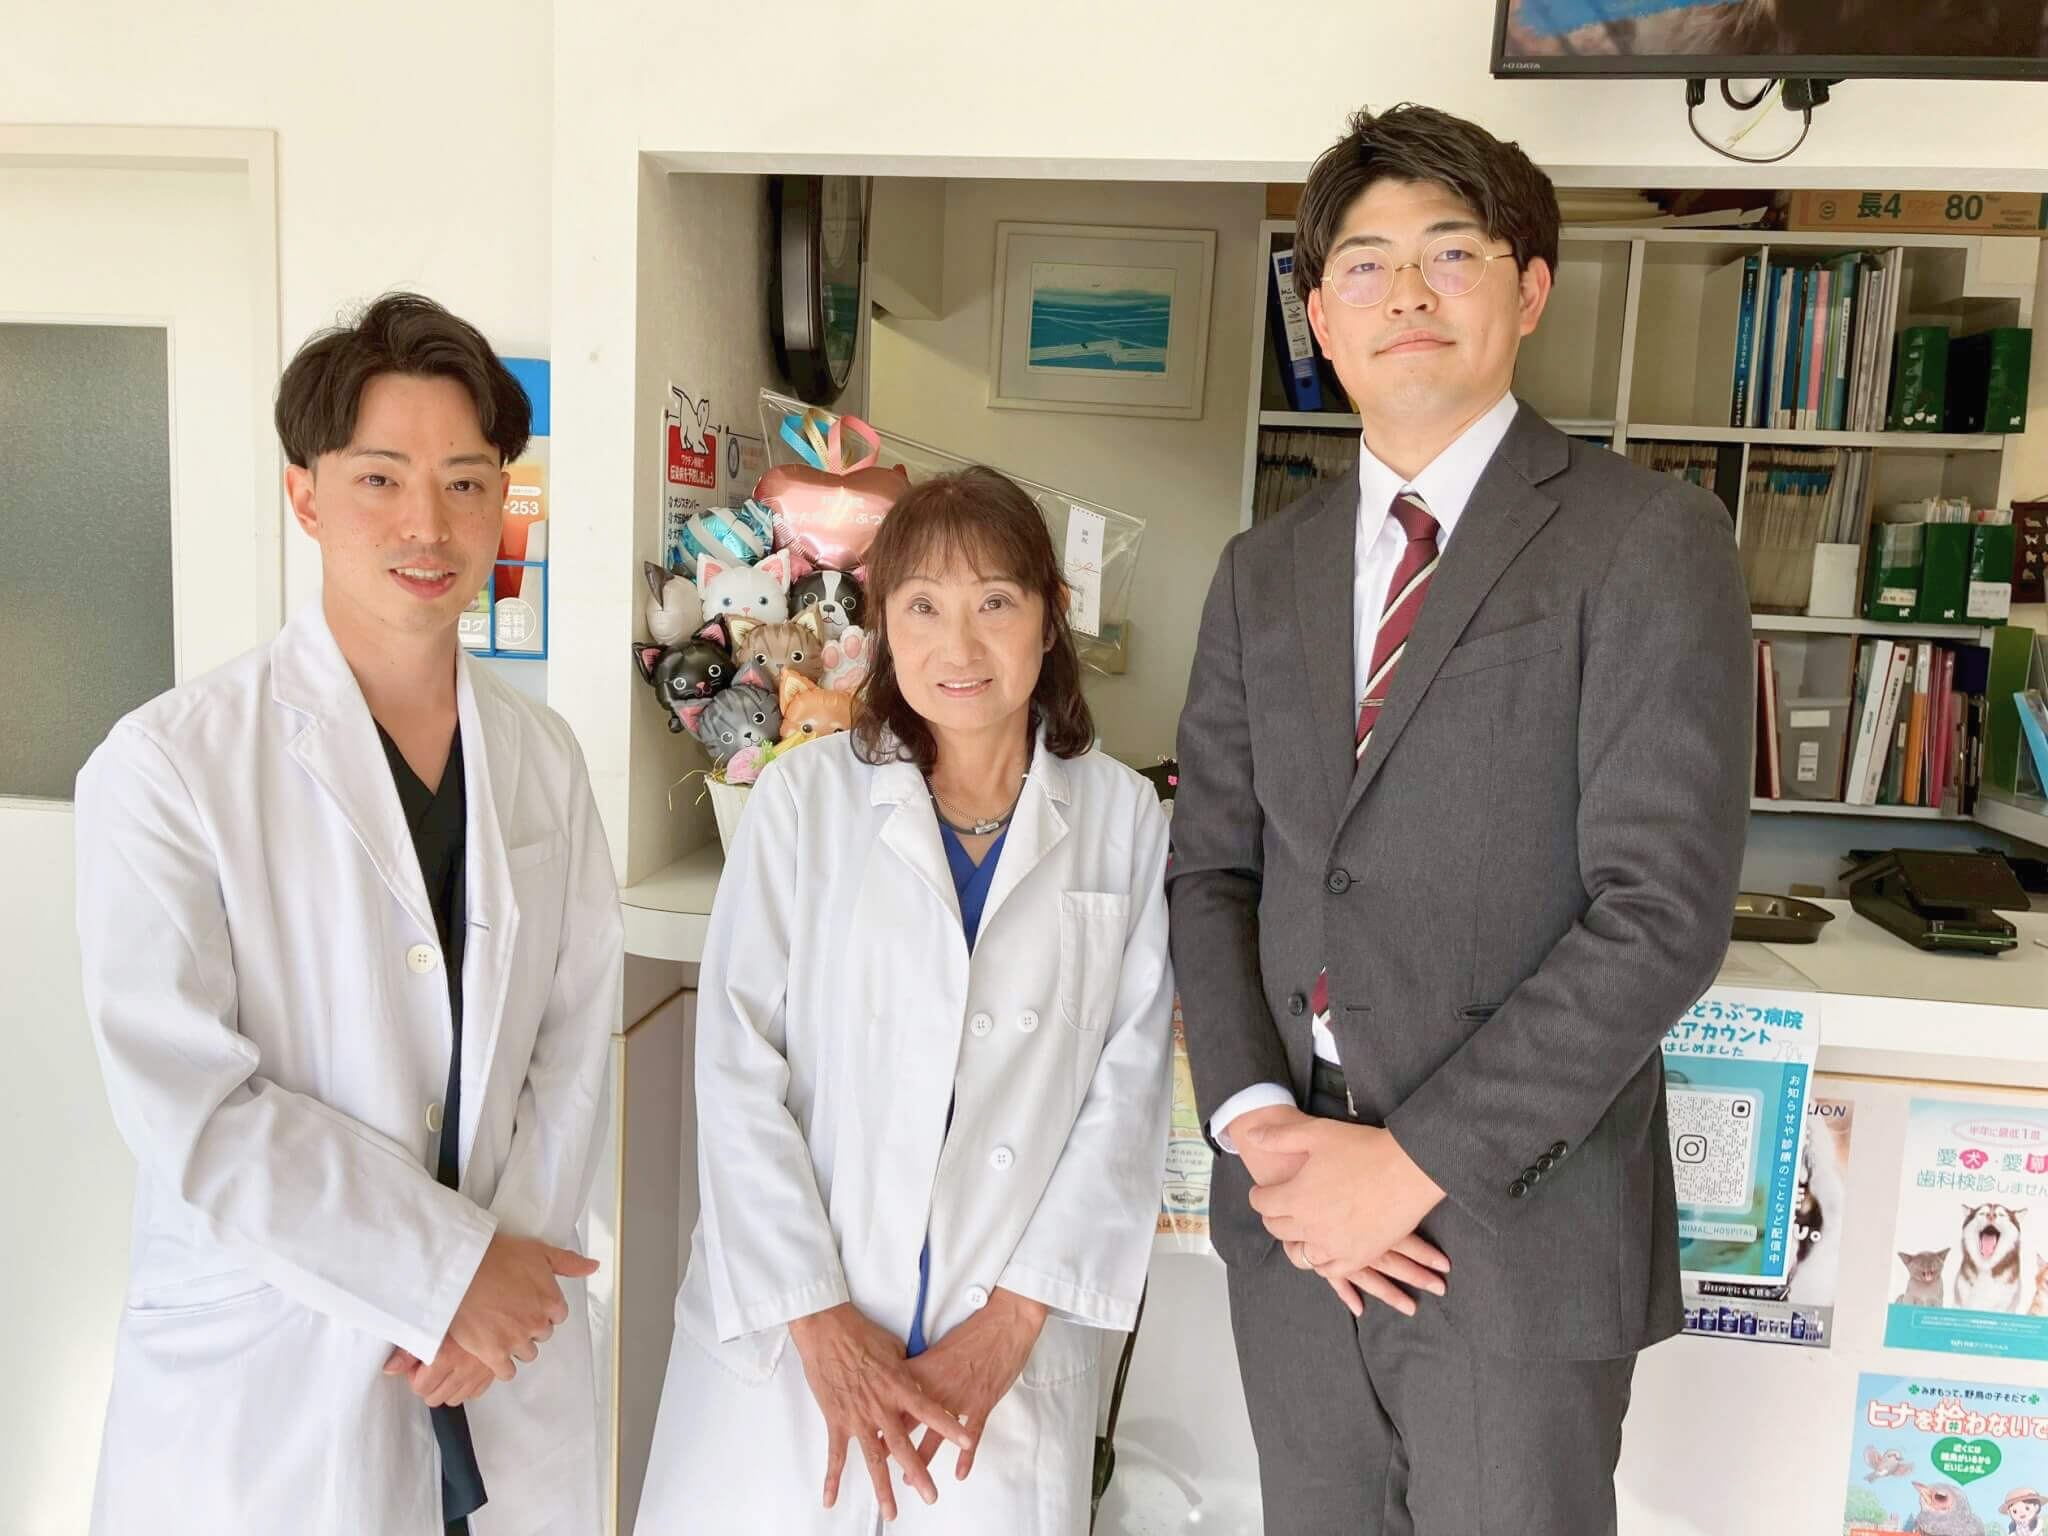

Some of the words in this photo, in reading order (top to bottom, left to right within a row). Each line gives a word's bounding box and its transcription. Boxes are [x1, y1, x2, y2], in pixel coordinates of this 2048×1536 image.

[1857, 192, 1902, 219] 長4
[1945, 194, 1984, 221] 80
[1683, 1001, 1804, 1030] どうぶつ病院
[1665, 1042, 1744, 1058] はじめました
[1807, 1103, 1847, 1118] LION
